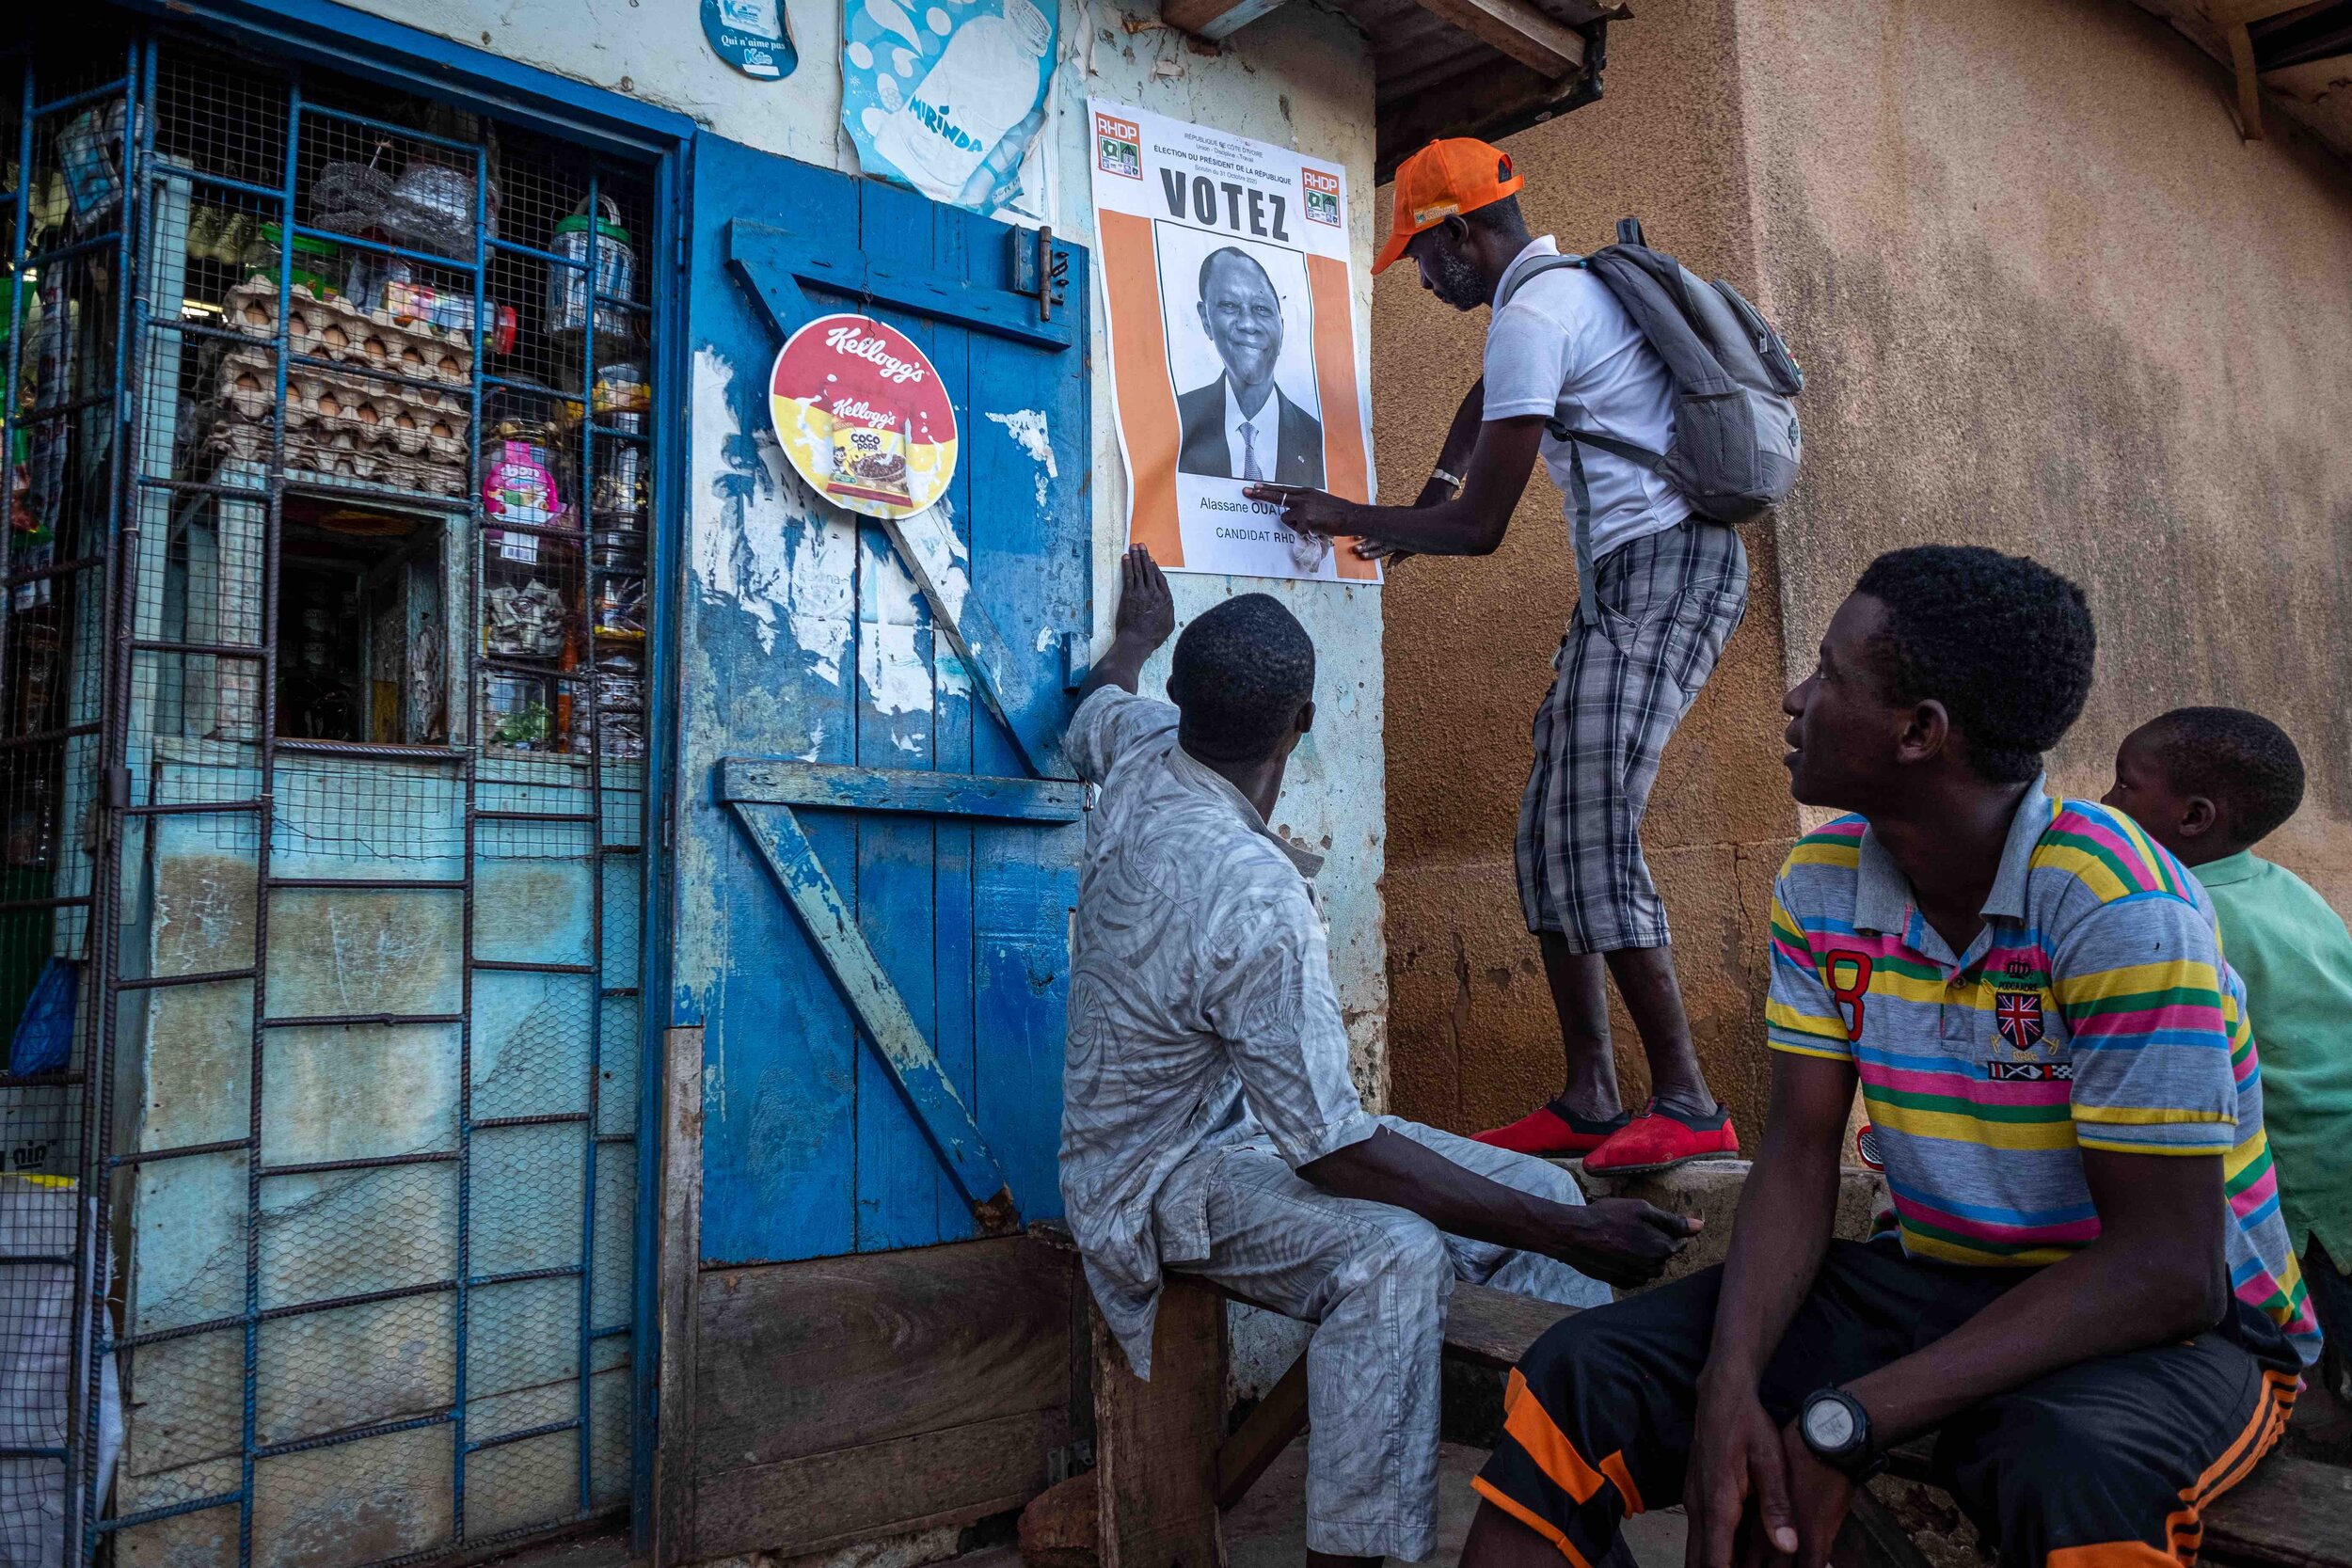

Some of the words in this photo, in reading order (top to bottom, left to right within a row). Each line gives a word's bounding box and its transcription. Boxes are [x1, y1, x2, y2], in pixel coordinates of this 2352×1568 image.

[721, 34, 739, 48] Qui
[770, 41, 787, 52] pas
[1098, 117, 1138, 141] RHDP
[1196, 143, 1210, 151] Union
[1153, 144, 1187, 159] ÉLECTION
[1199, 155, 1234, 170] PRÉSIDENT
[1235, 164, 1245, 172] DE
[1254, 167, 1292, 185] RÉPUBLIQUE
[1195, 165, 1212, 173] Scrutin
[1227, 172, 1246, 182] Octobre
[1304, 172, 1338, 193] RHDP
[1159, 166, 1289, 243] VOTEZ
[825, 326, 926, 384] Kellogg's
[833, 397, 897, 430] Kellogg's
[1200, 497, 1248, 513] Alassane
[1251, 501, 1289, 516] OUAT
[1216, 528, 1270, 542] CANDIDAT
[1273, 532, 1295, 544] RHD
